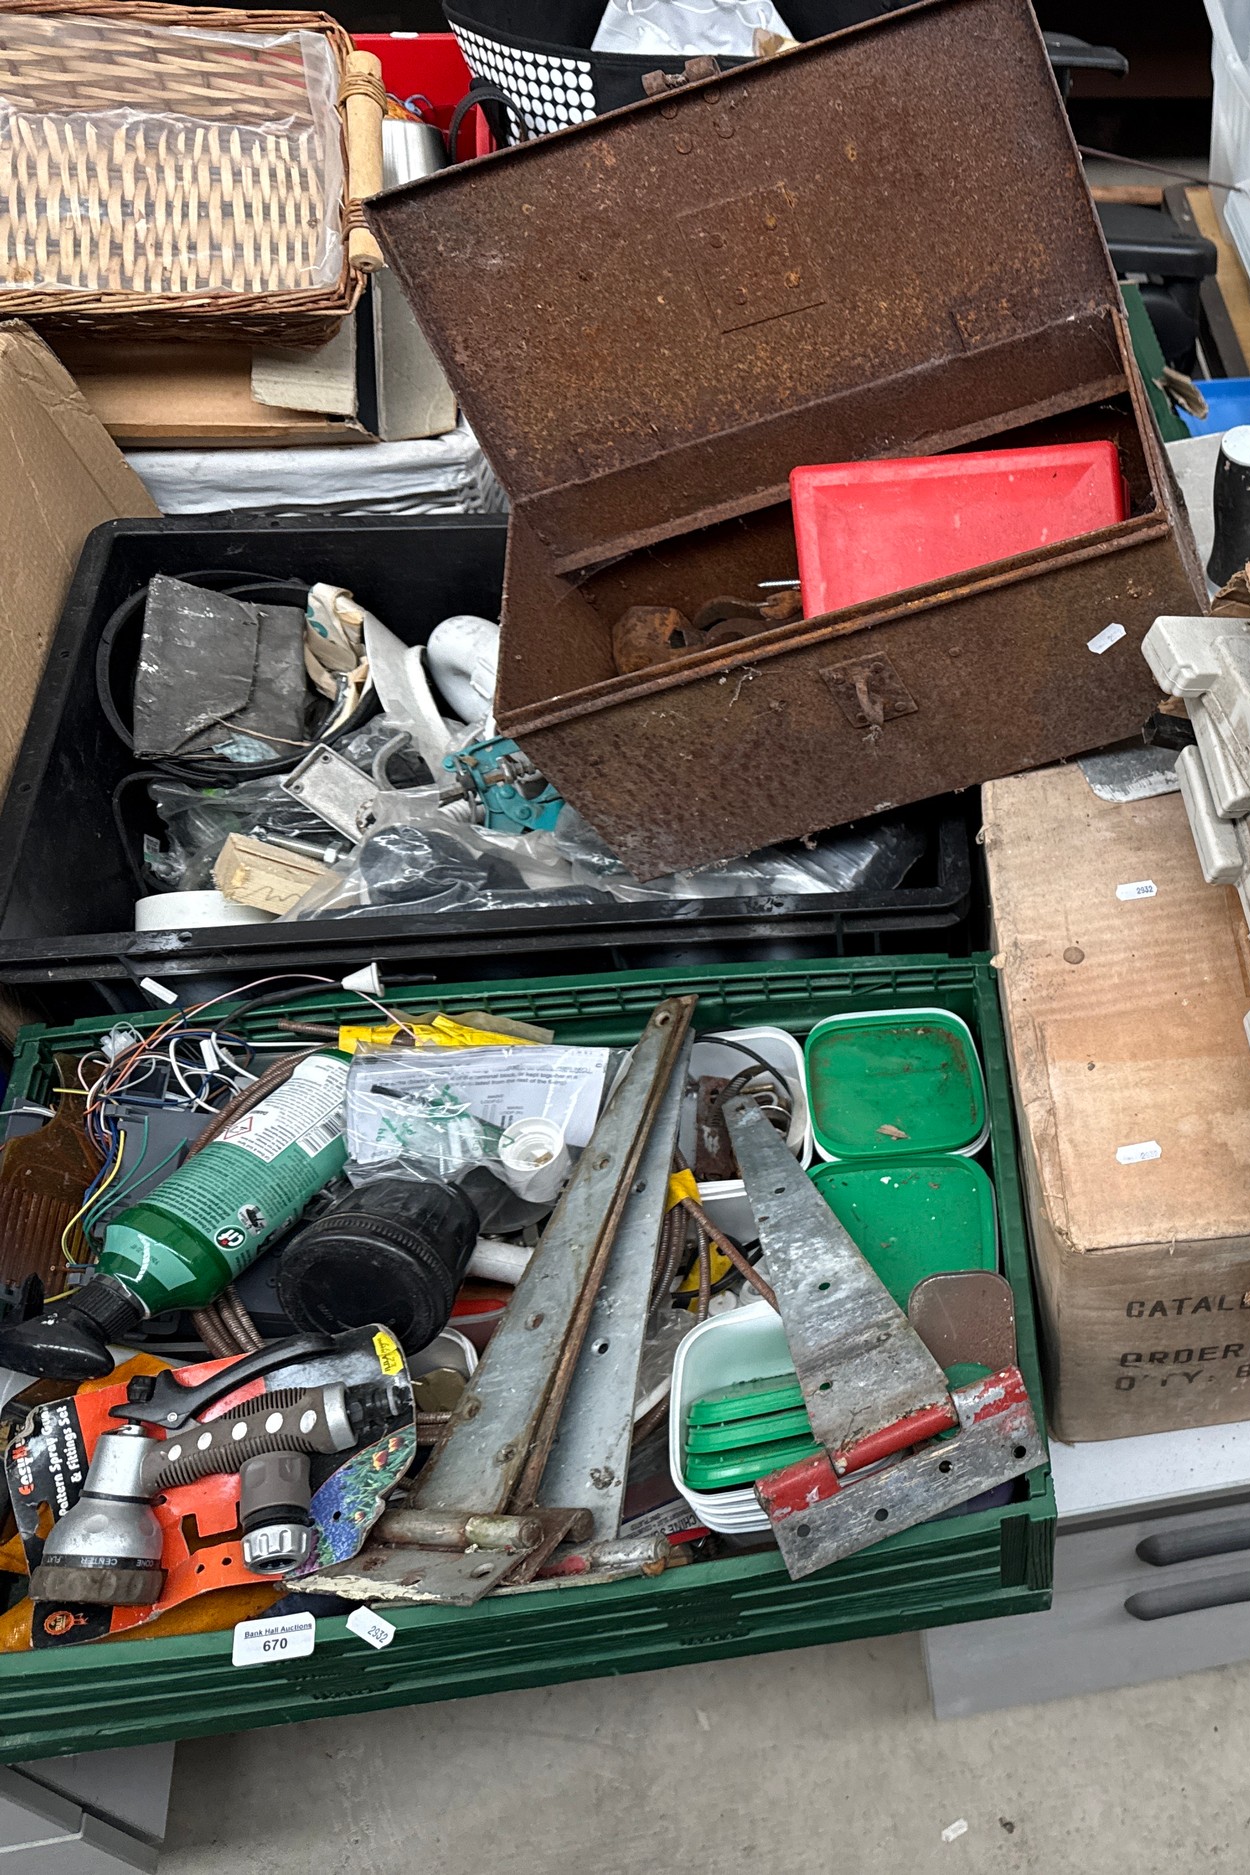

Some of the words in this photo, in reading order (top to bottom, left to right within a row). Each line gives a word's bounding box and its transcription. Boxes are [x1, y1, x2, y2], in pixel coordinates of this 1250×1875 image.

[218, 1229, 244, 1247] Cif
[1120, 1343, 1244, 1368] ORDER
[56, 1406, 70, 1426] Set
[46, 1437, 63, 1473] Spray
[63, 1428, 80, 1470] Fittings
[70, 1471, 82, 1483] &
[53, 1474, 69, 1517] Pattern
[80, 1556, 118, 1565] CENTER
[244, 1629, 263, 1639] Bank
[264, 1626, 279, 1636] Hall
[281, 1622, 313, 1632] Auctions
[367, 1625, 388, 1643] 2932
[263, 1637, 288, 1651] 670
